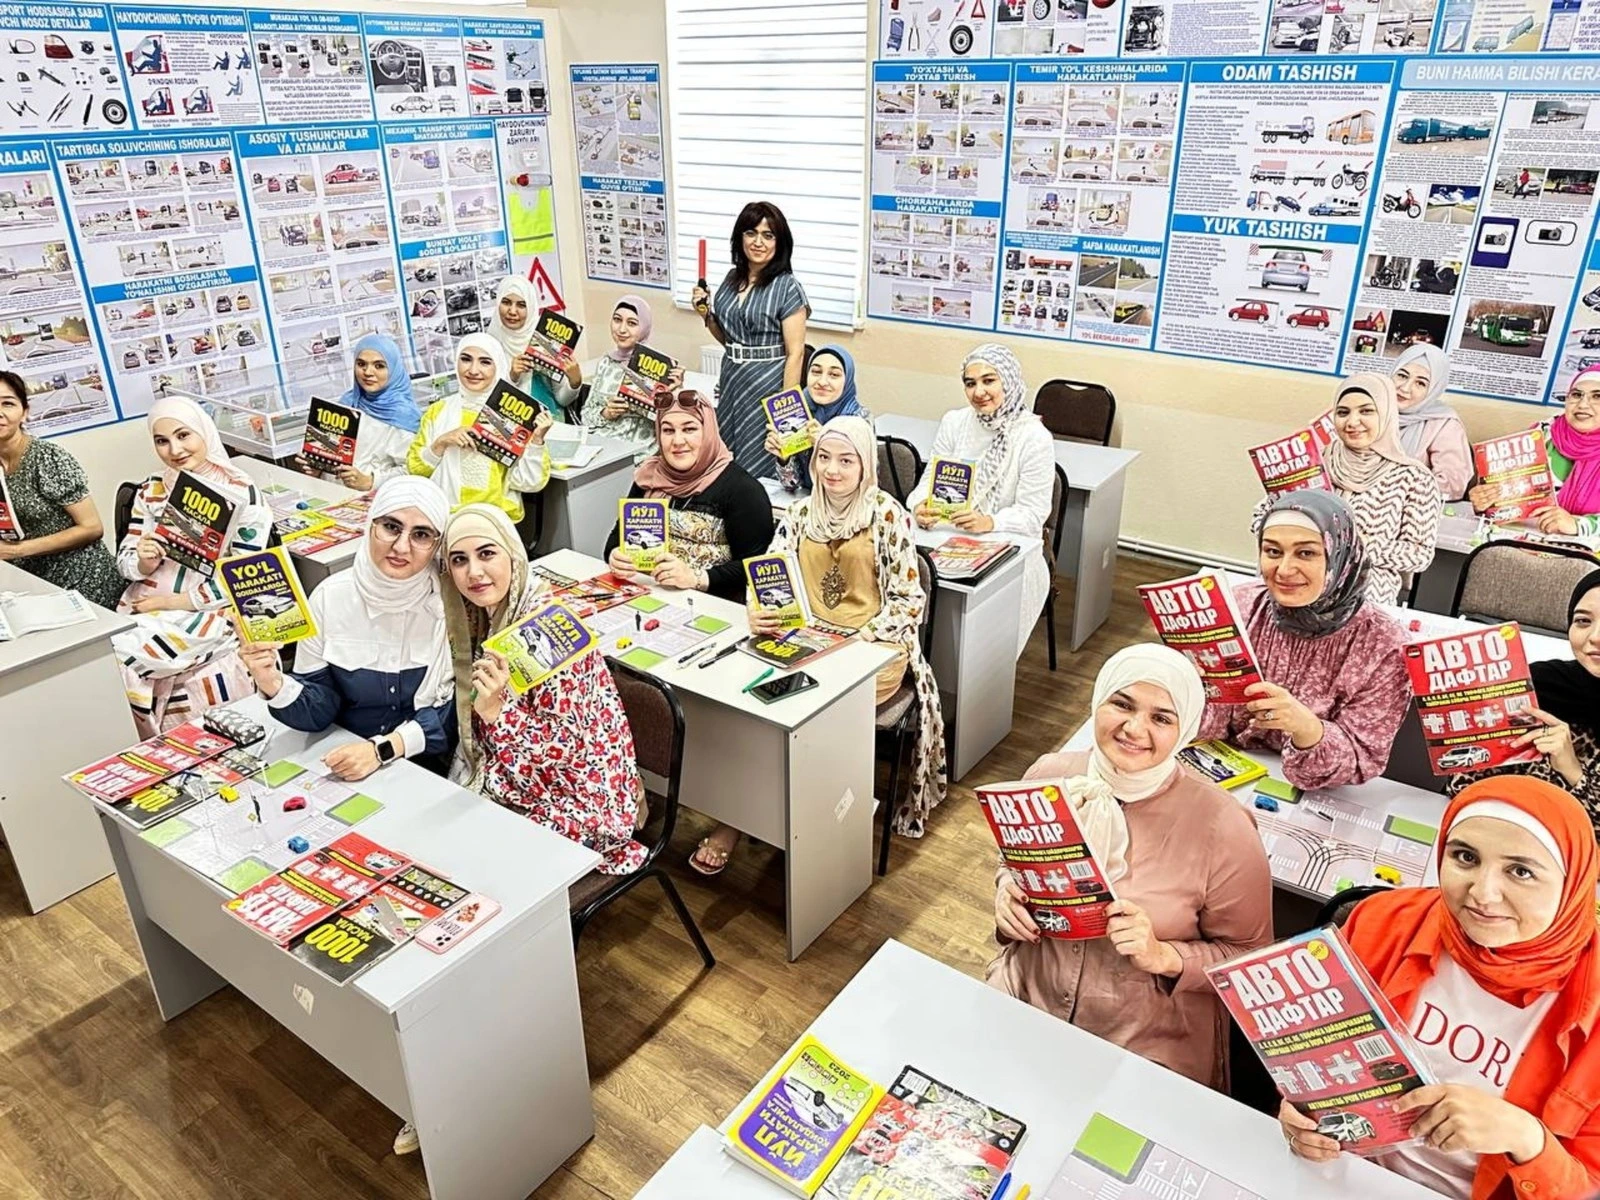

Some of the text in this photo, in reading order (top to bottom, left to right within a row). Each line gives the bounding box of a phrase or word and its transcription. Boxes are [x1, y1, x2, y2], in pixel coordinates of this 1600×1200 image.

[51, 19, 91, 29] DETALLAR
[115, 11, 180, 24] HAYDOVCHINING
[940, 74, 976, 82] TURISH
[1030, 65, 1058, 74] TEMIR
[1083, 65, 1168, 74] KESISHMALARIDA
[1057, 74, 1136, 82] HARAKATLANISH
[1222, 65, 1358, 81] ODAM TASHISH
[1416, 65, 1449, 80] BUNI
[1451, 67, 1501, 81] HAMMA
[1507, 67, 1558, 81] BILISHI
[56, 136, 230, 157] TARTIBGA SOLUVCHINING ISHORALARI
[249, 128, 369, 145] ASOSIY TUSHUNCHALAR
[278, 141, 347, 155] VA ATAMALAR
[895, 197, 974, 208] CHORRAHALARDA
[896, 204, 972, 215] HARAKATLANISH
[1203, 216, 1328, 241] YUK TASHISH
[1082, 240, 1104, 250] SAFDA
[1105, 242, 1160, 255] HARAKATLANISH
[124, 279, 173, 291] HARAKATNI
[545, 318, 573, 341] 1000
[638, 353, 667, 376] 1000
[499, 391, 535, 421] 1000
[316, 408, 350, 430] 1000
[1256, 436, 1306, 467] АВТО
[1486, 434, 1536, 462] АВТО
[941, 464, 966, 478] ЙЎЛ
[1263, 454, 1310, 481] ДАФТАР
[1488, 452, 1537, 475] ДАФТАР
[181, 487, 221, 522] 1000
[183, 506, 211, 526] МАСАЛА
[631, 506, 658, 518] ЙЎЛ
[233, 572, 283, 591] HARAKATI
[756, 563, 781, 577] ЙЎЛ
[1147, 582, 1212, 615] АВТО
[551, 611, 583, 643] ЙЎЛ
[1160, 608, 1218, 632] ДАФТАР
[756, 640, 800, 658] 1000
[1423, 630, 1508, 673] АВТО
[1429, 660, 1512, 693] ДАФТАР
[986, 791, 1056, 825] АВТО
[999, 823, 1064, 846] ДАФТАР
[238, 888, 304, 934] АВТО
[335, 917, 374, 942] МАСАЛА
[304, 922, 369, 964] 1000
[1229, 948, 1331, 1009] АВТО
[1251, 987, 1344, 1036] ДАФТАР
[1413, 1001, 1511, 1087] DOR
[828, 1062, 851, 1081] 2023
[753, 1123, 808, 1169] ЙЎЛ
